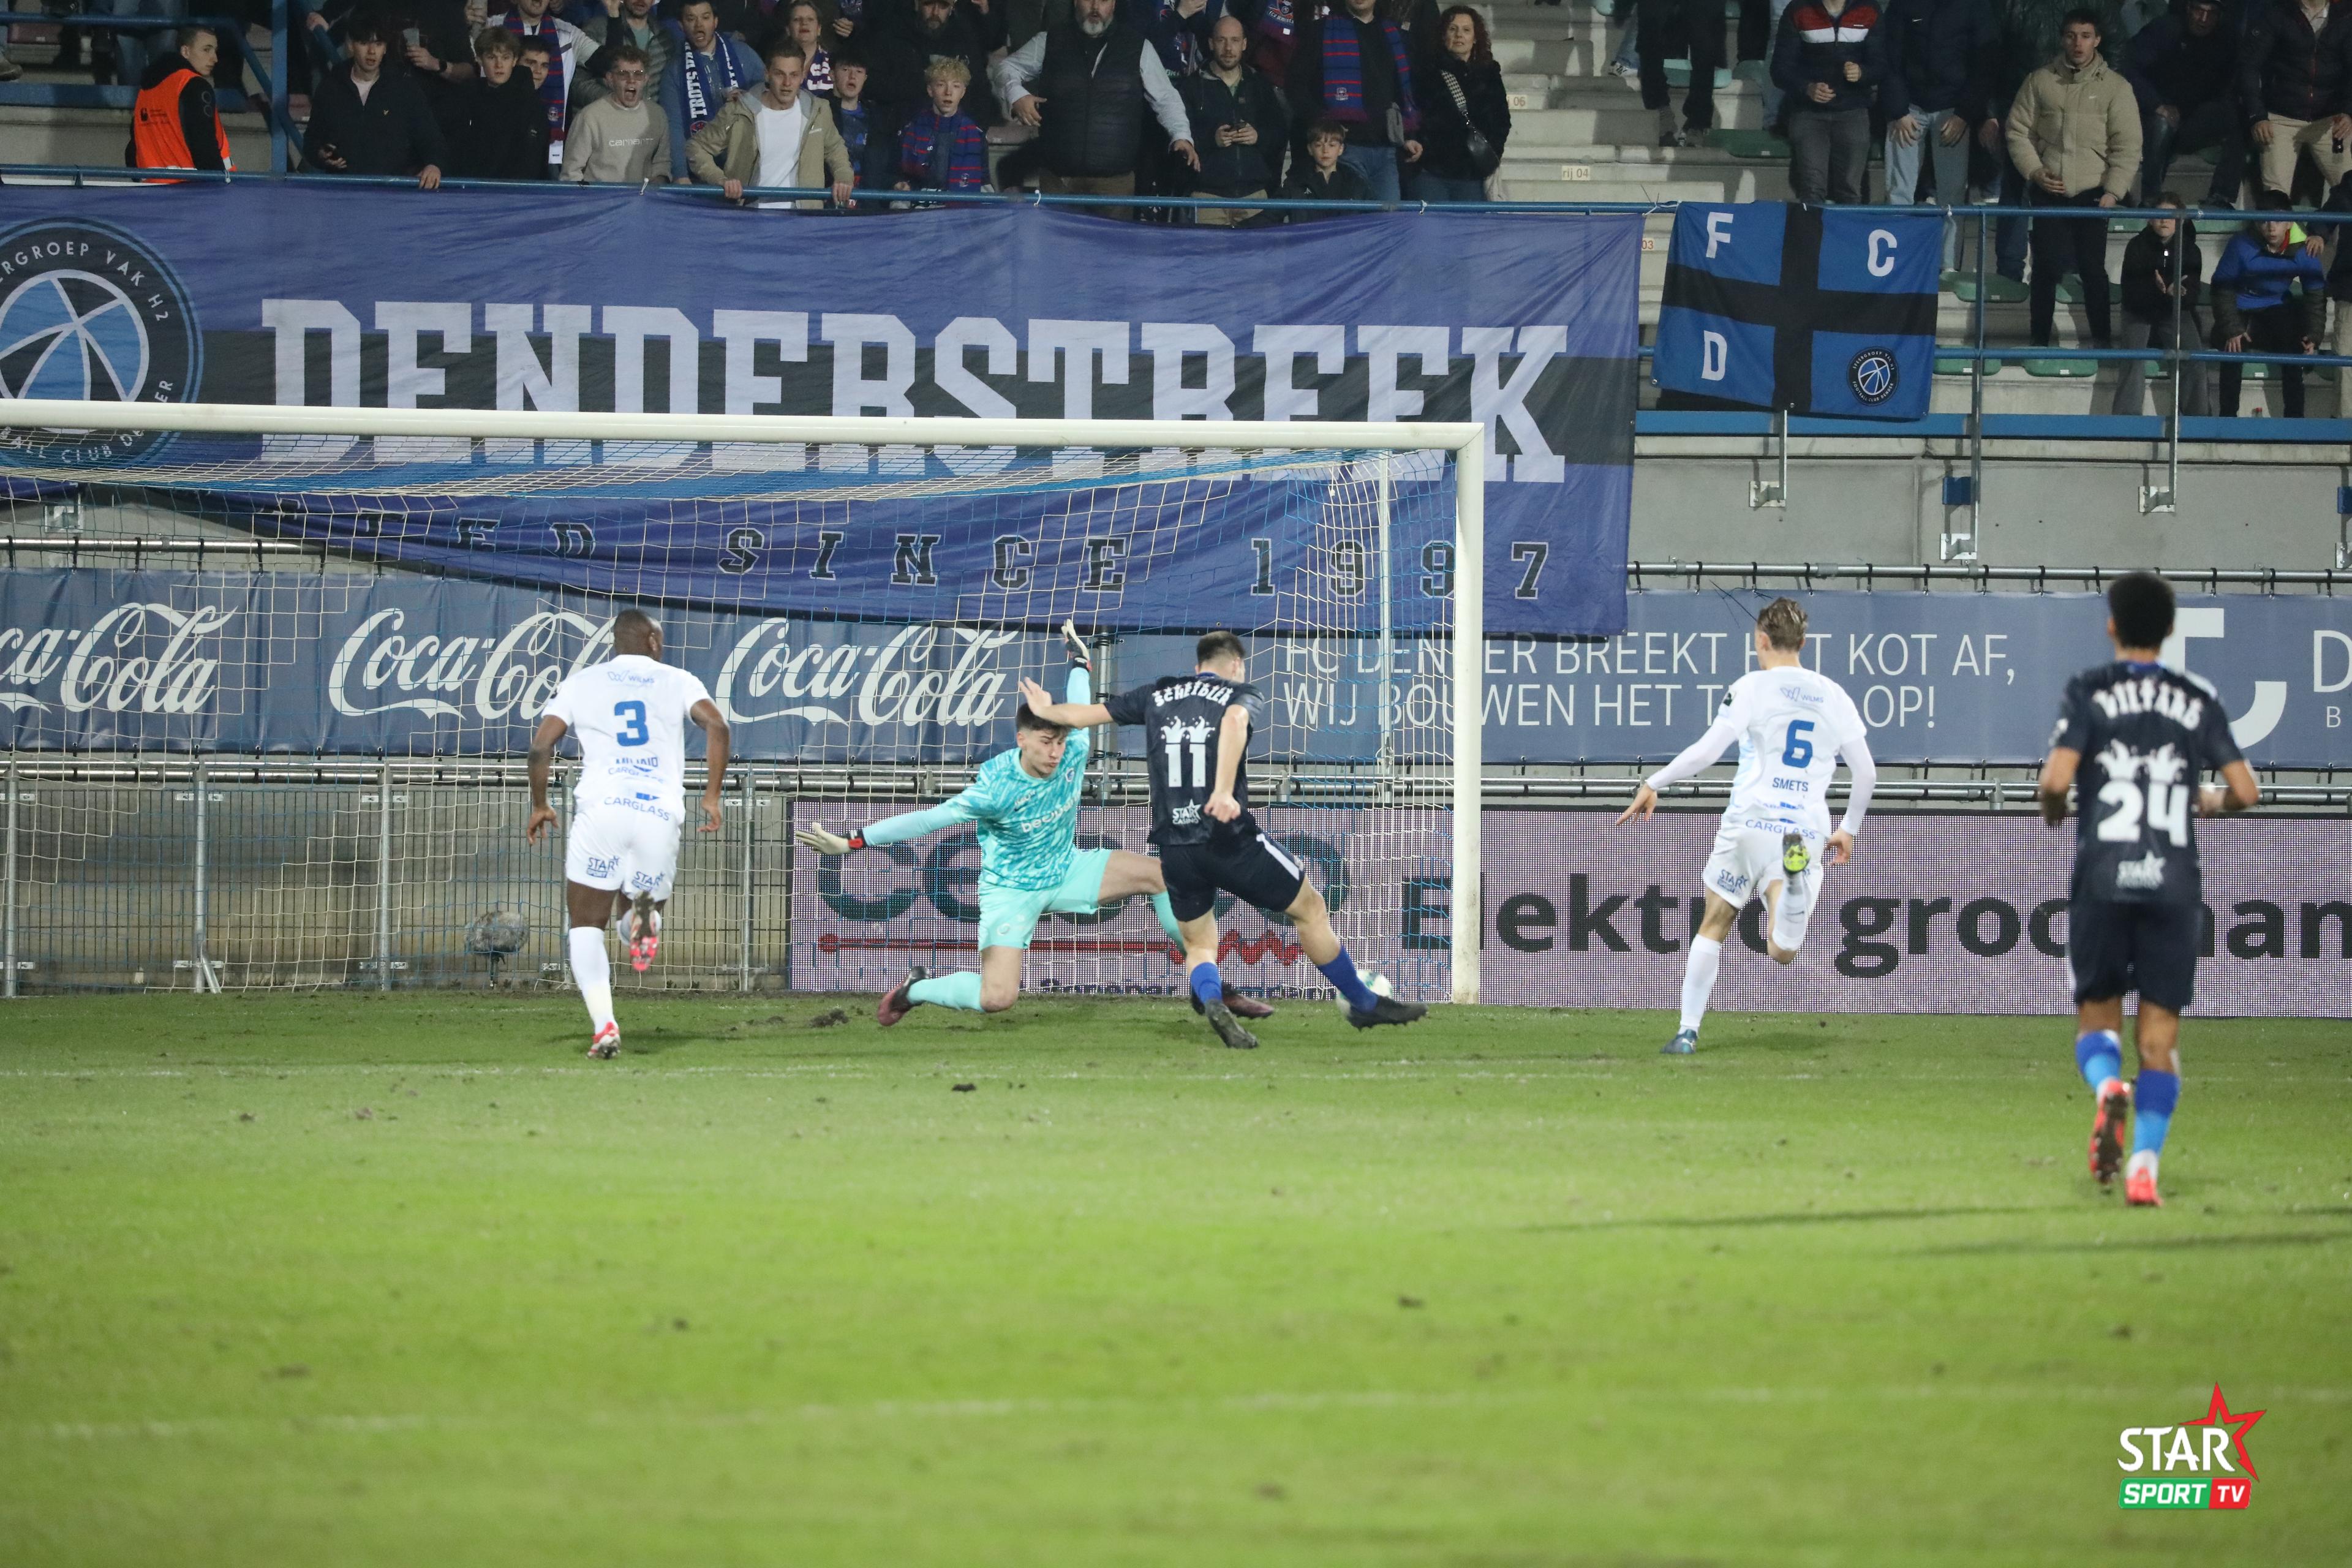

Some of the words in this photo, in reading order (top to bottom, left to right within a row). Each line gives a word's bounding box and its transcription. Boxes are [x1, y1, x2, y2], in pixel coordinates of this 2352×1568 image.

[687, 71, 707, 118] TROTS
[1577, 168, 1589, 178] 04
[1706, 211, 1734, 258] F
[1867, 229, 1898, 277] C
[0, 241, 89, 283] RGROEP
[107, 250, 145, 287] VAK
[148, 294, 169, 321] H2
[1701, 330, 1727, 381] D
[261, 299, 1567, 483] DENDERSTREEK
[62, 443, 112, 463] CLUB
[718, 527, 1128, 594] SINCE
[1250, 538, 1550, 600] 1997
[1357, 635, 1537, 673] DENER
[1556, 633, 1727, 674] BREEKT
[1849, 634, 1937, 675] KOT
[1952, 634, 2015, 685] AF,
[614, 700, 650, 747] 3
[1284, 682, 1357, 726] WIJ
[1596, 684, 1681, 726] HET
[1863, 685, 1934, 728] OP!
[1163, 737, 1208, 788] 11
[1782, 719, 1815, 768] 6
[1773, 777, 1809, 792] SMETS
[604, 797, 669, 821] CARGLASS
[2097, 773, 2190, 848] 24
[588, 857, 615, 870] STAR
[634, 870, 661, 886] STAR
[1719, 869, 1743, 889] STAR
